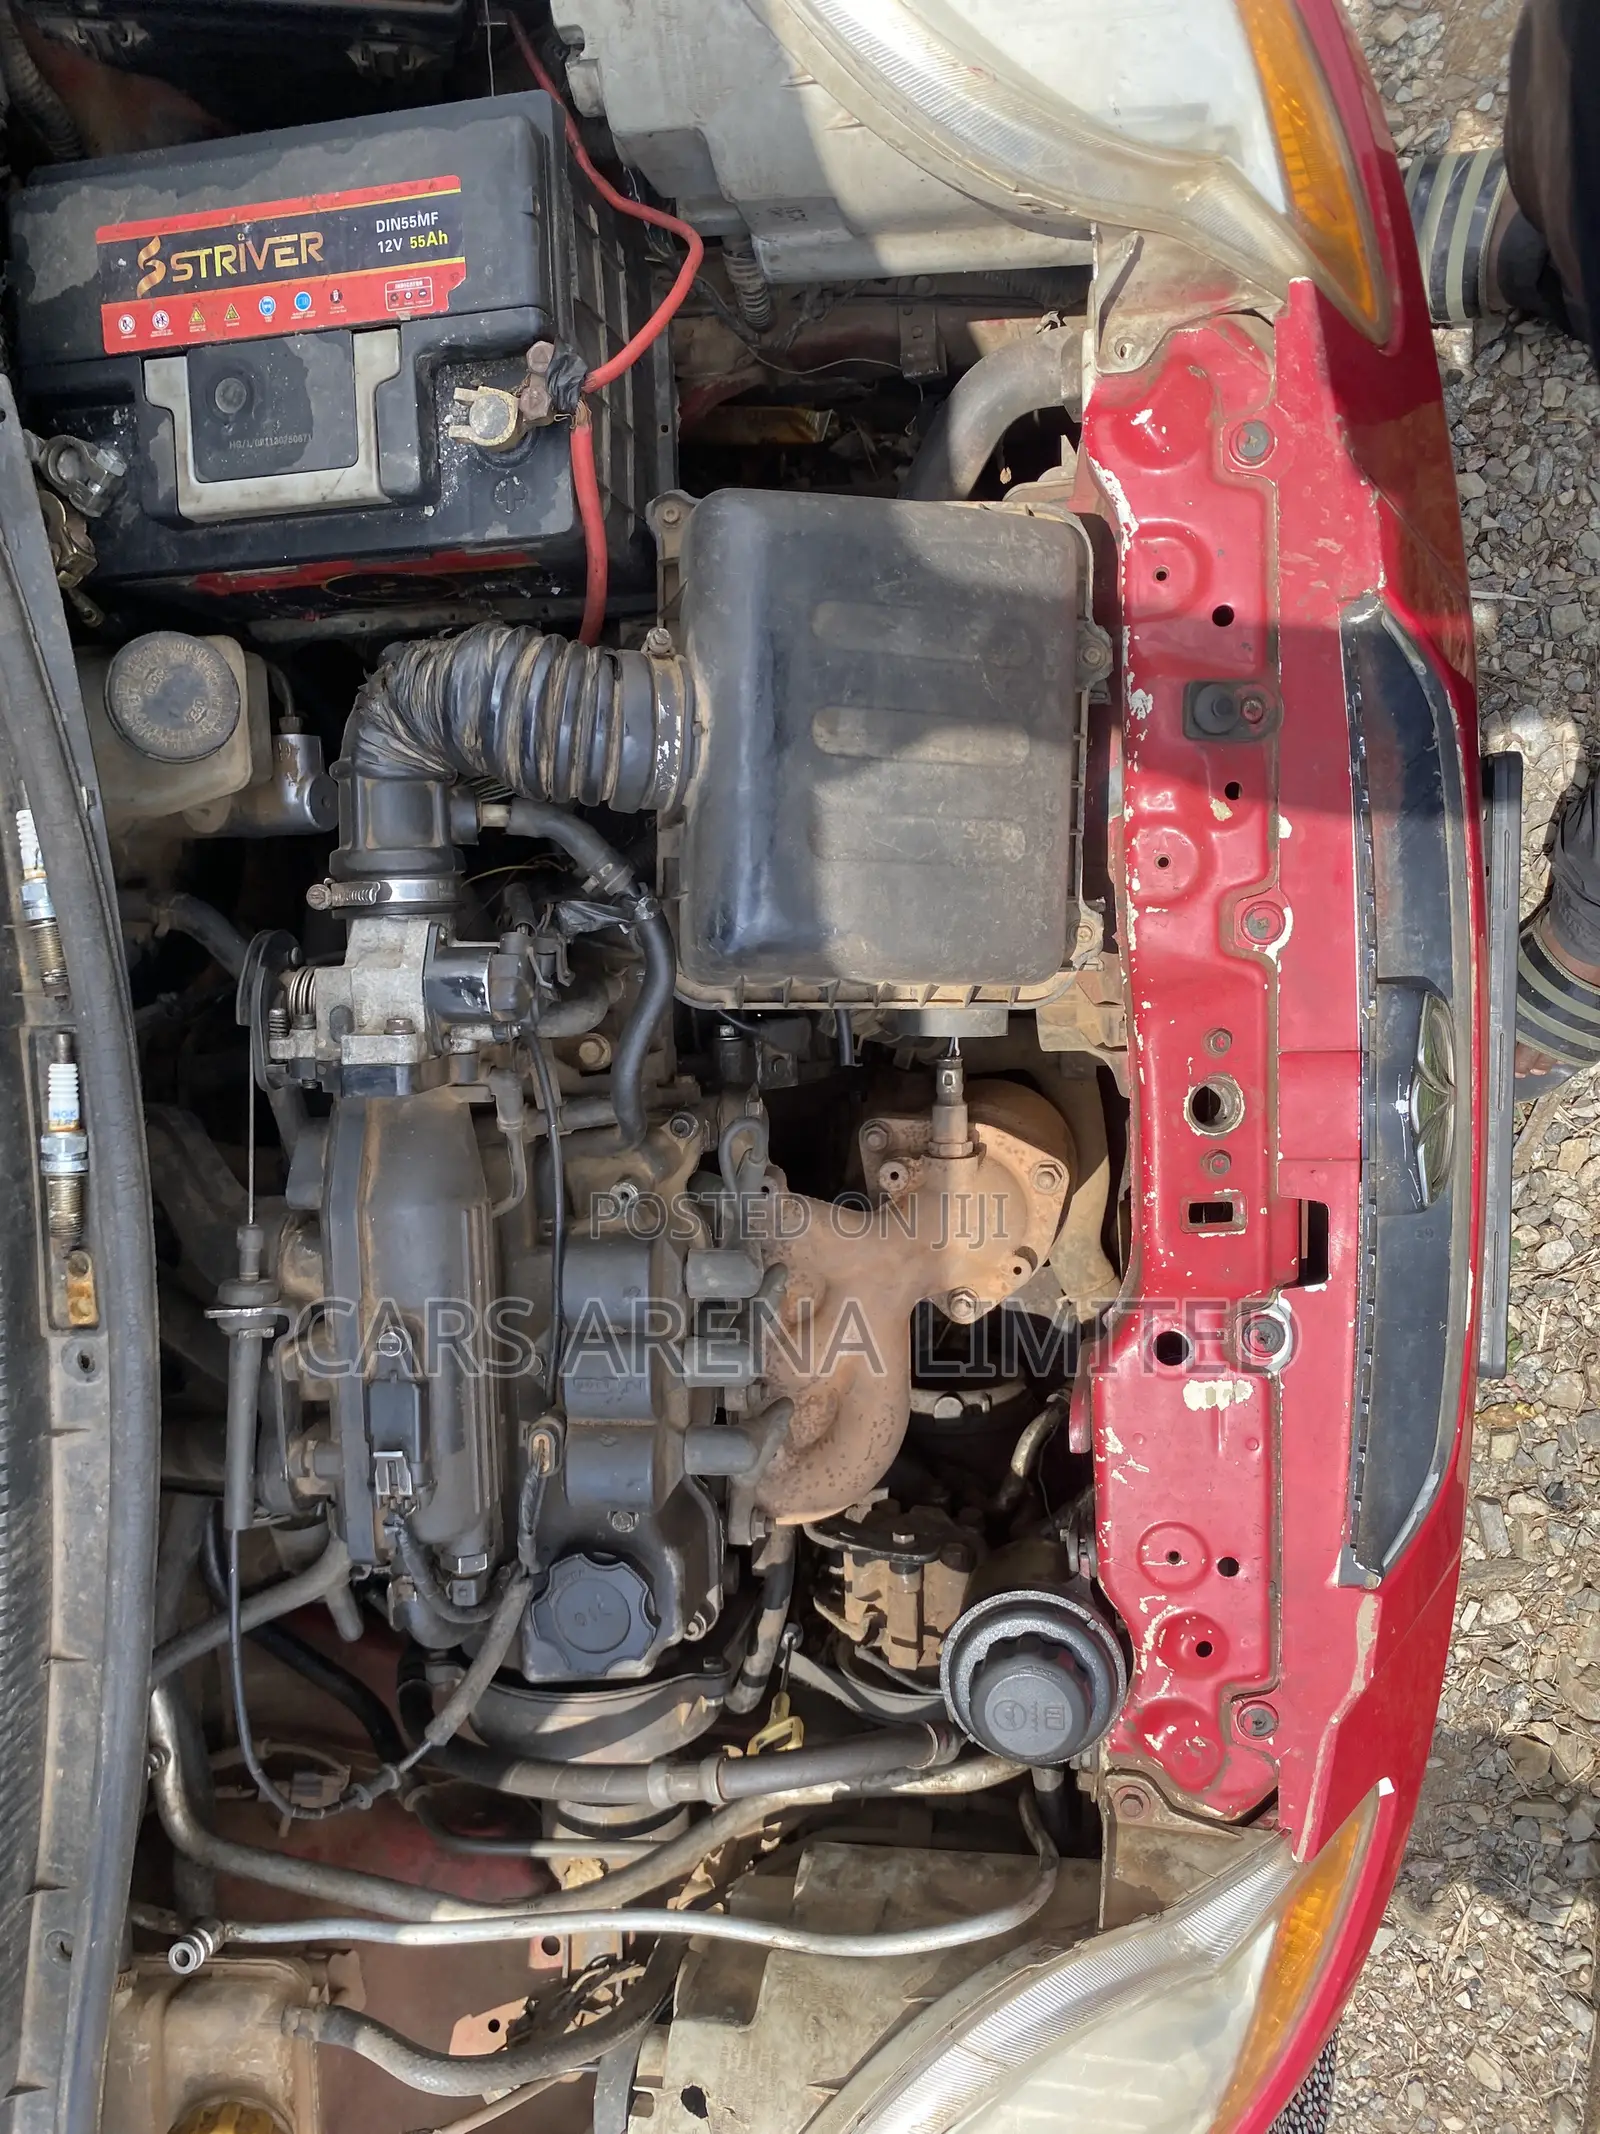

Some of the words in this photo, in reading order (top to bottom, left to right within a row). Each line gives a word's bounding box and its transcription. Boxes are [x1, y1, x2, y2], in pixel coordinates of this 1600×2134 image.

[375, 211, 439, 233] DIN55MF
[377, 237, 403, 254] 12V
[409, 230, 448, 250] 55Ah
[169, 231, 324, 282] STRIVER
[53, 1110, 76, 1118] NGK
